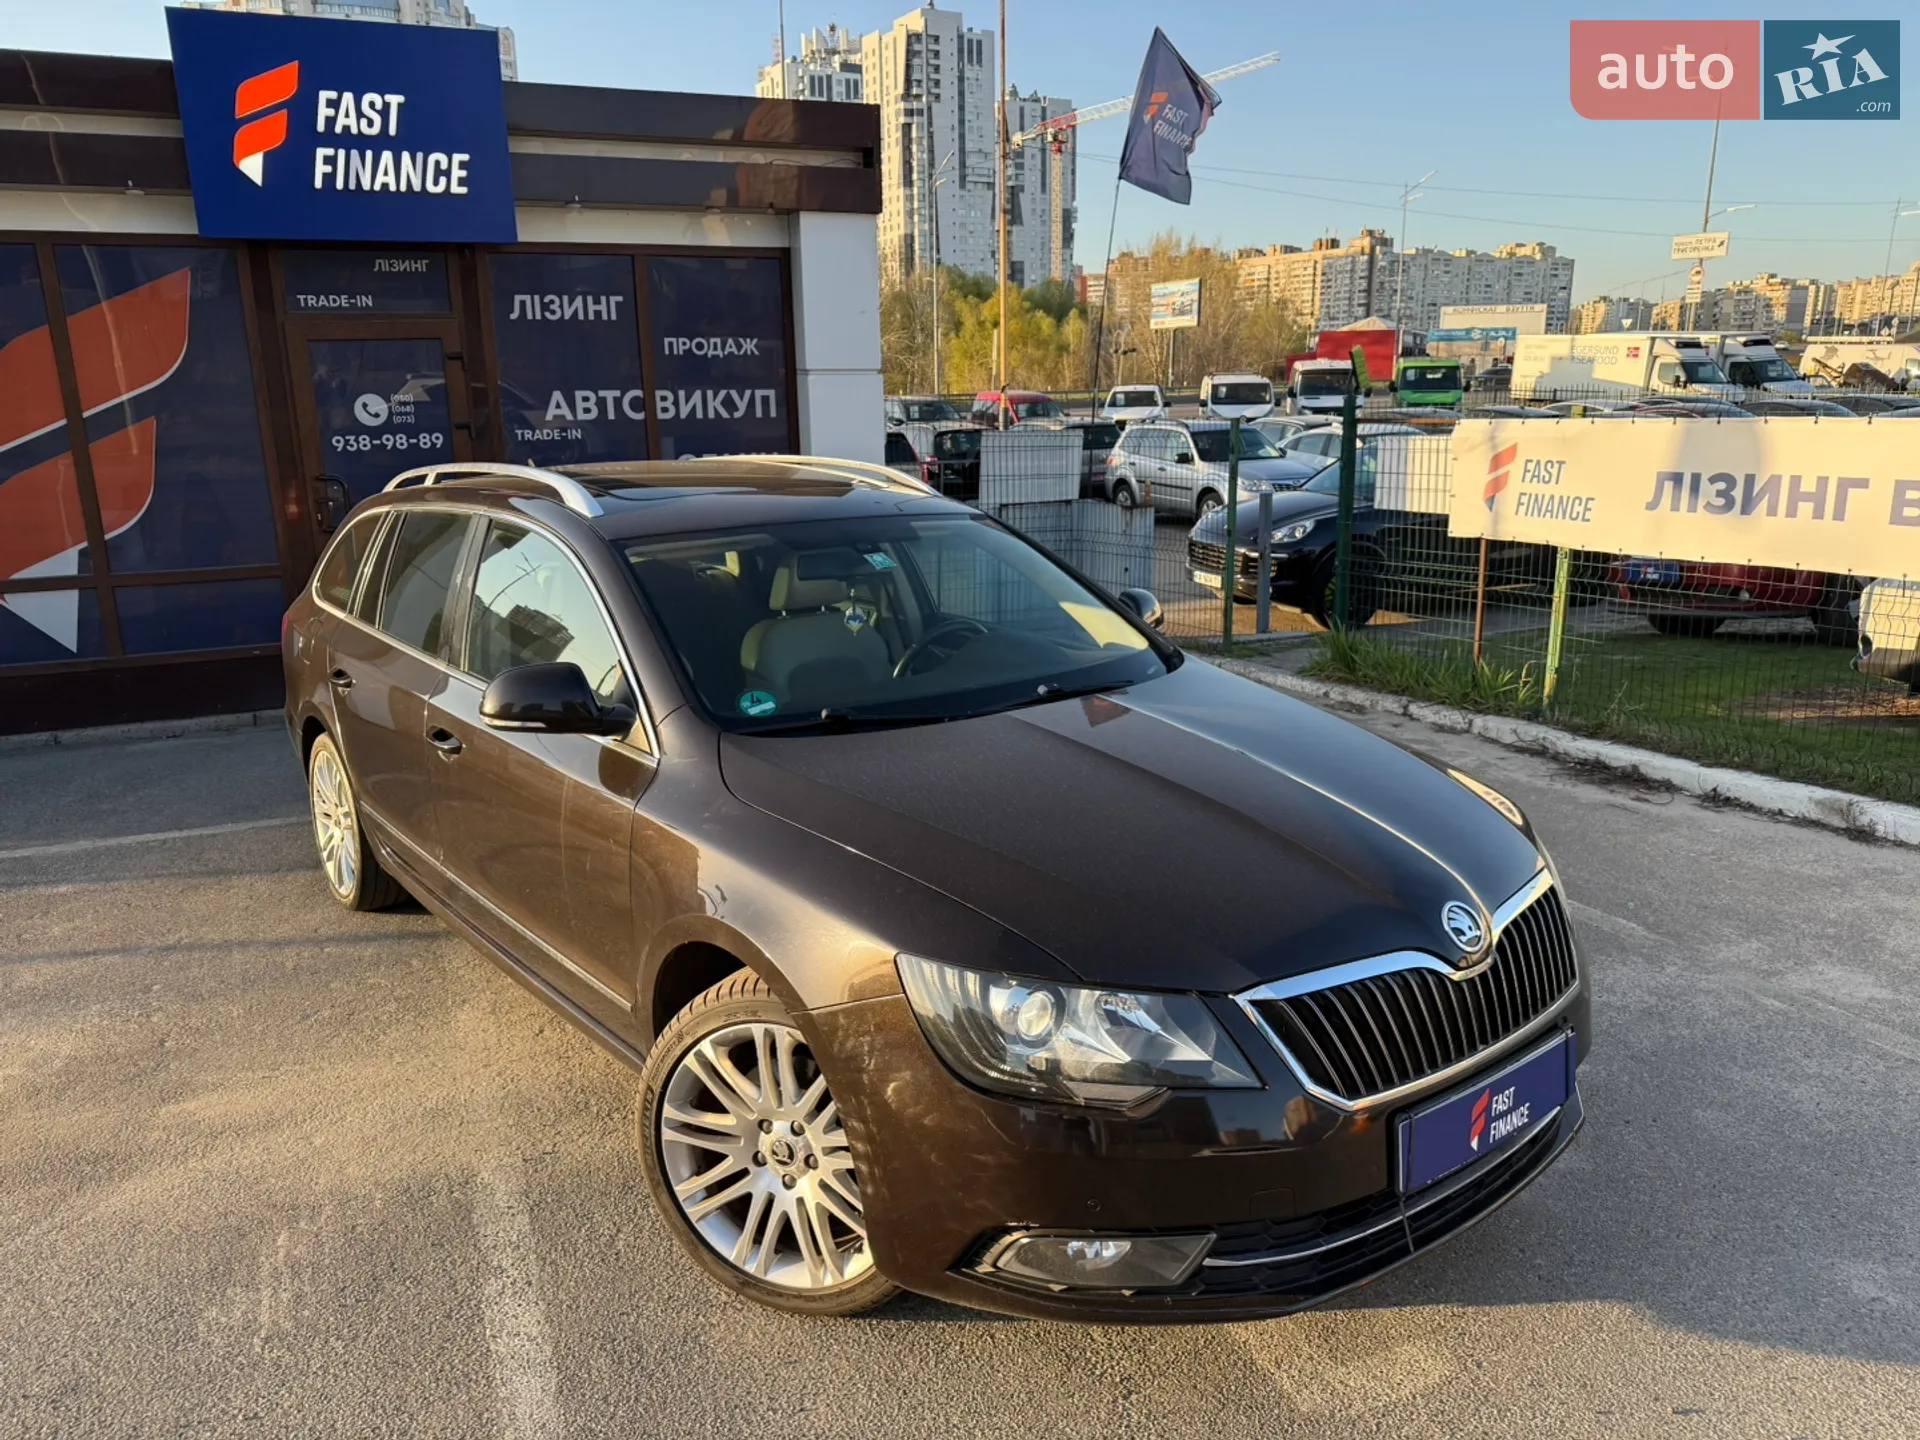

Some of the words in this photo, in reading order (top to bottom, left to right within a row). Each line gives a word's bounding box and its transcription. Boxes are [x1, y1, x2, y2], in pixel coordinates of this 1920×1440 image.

[316, 89, 406, 137] FAST
[1162, 103, 1189, 125] FAST
[314, 147, 470, 195] FINANCE
[373, 259, 429, 272] ЛІЗИНГ
[296, 294, 373, 308] TRADE-IN
[509, 294, 623, 321] ЛІЗИНГ
[663, 337, 759, 358] ПРОДАЖ
[1571, 345, 1619, 355] EGERSUND
[331, 432, 444, 452] 938-98-89
[515, 429, 582, 442] TRADE-IN
[1521, 458, 1566, 485] FAST
[1515, 491, 1596, 523] FINANCE
[1645, 470, 1870, 522] ЛІЗИНГ
[1491, 1086, 1516, 1117] FAST
[1489, 1102, 1531, 1144] FINANCE
